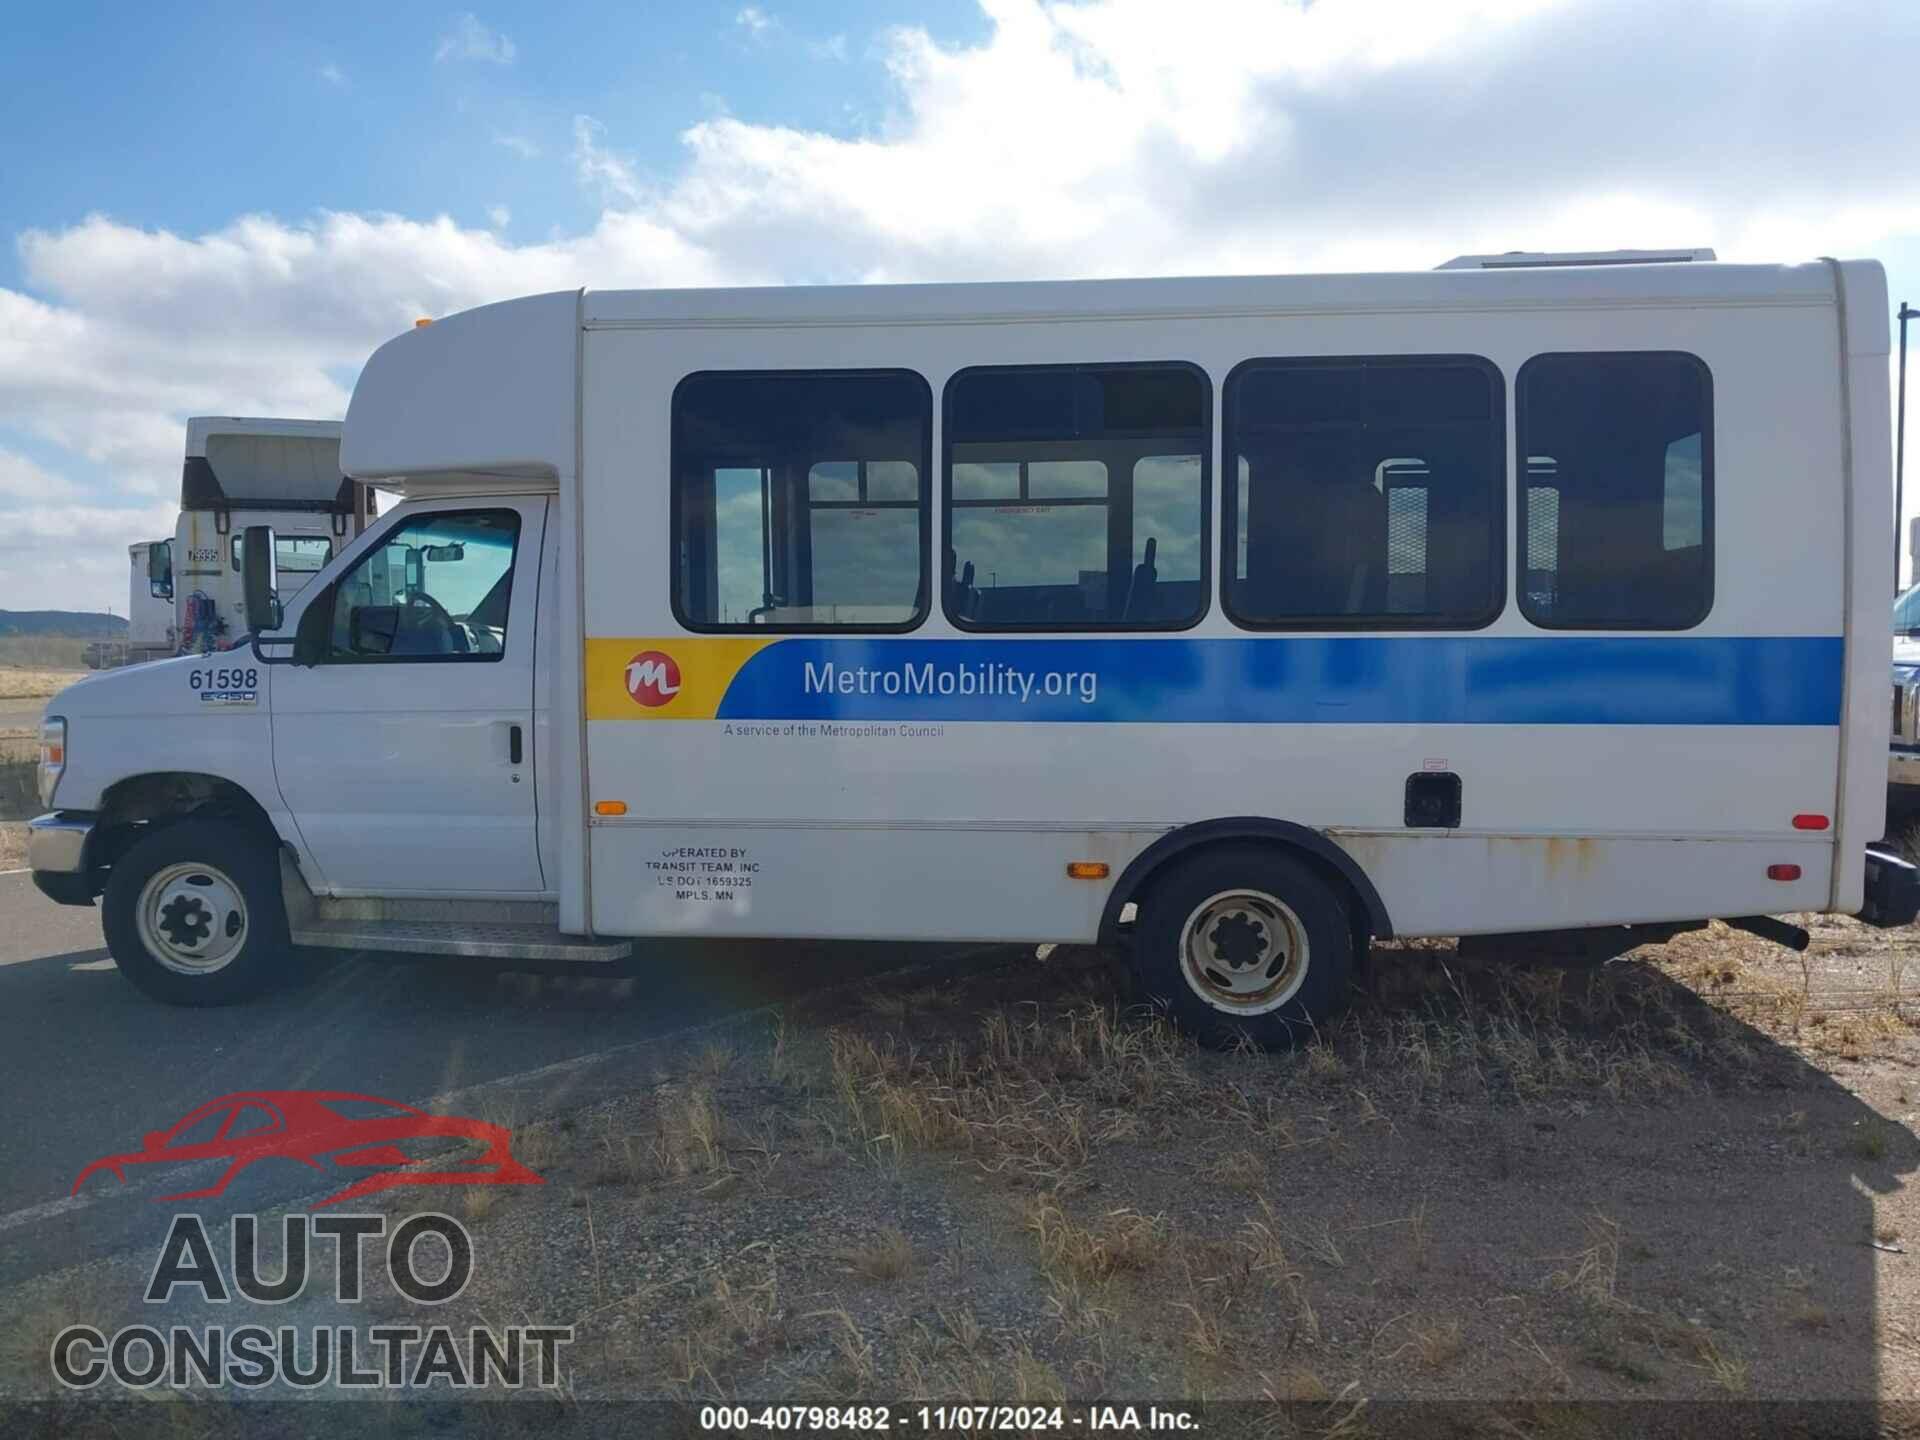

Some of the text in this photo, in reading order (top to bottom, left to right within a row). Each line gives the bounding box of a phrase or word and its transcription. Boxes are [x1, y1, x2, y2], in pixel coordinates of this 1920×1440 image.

[190, 668, 257, 690] 61598
[804, 661, 1098, 703] MetroMobility.org
[724, 724, 945, 739] A service of the Metropolitan Council
[662, 847, 747, 858] OPERATED BY
[645, 861, 697, 873] TRANSIT
[740, 862, 761, 873] INC
[706, 876, 752, 887] 1659325
[715, 890, 733, 901] MN
